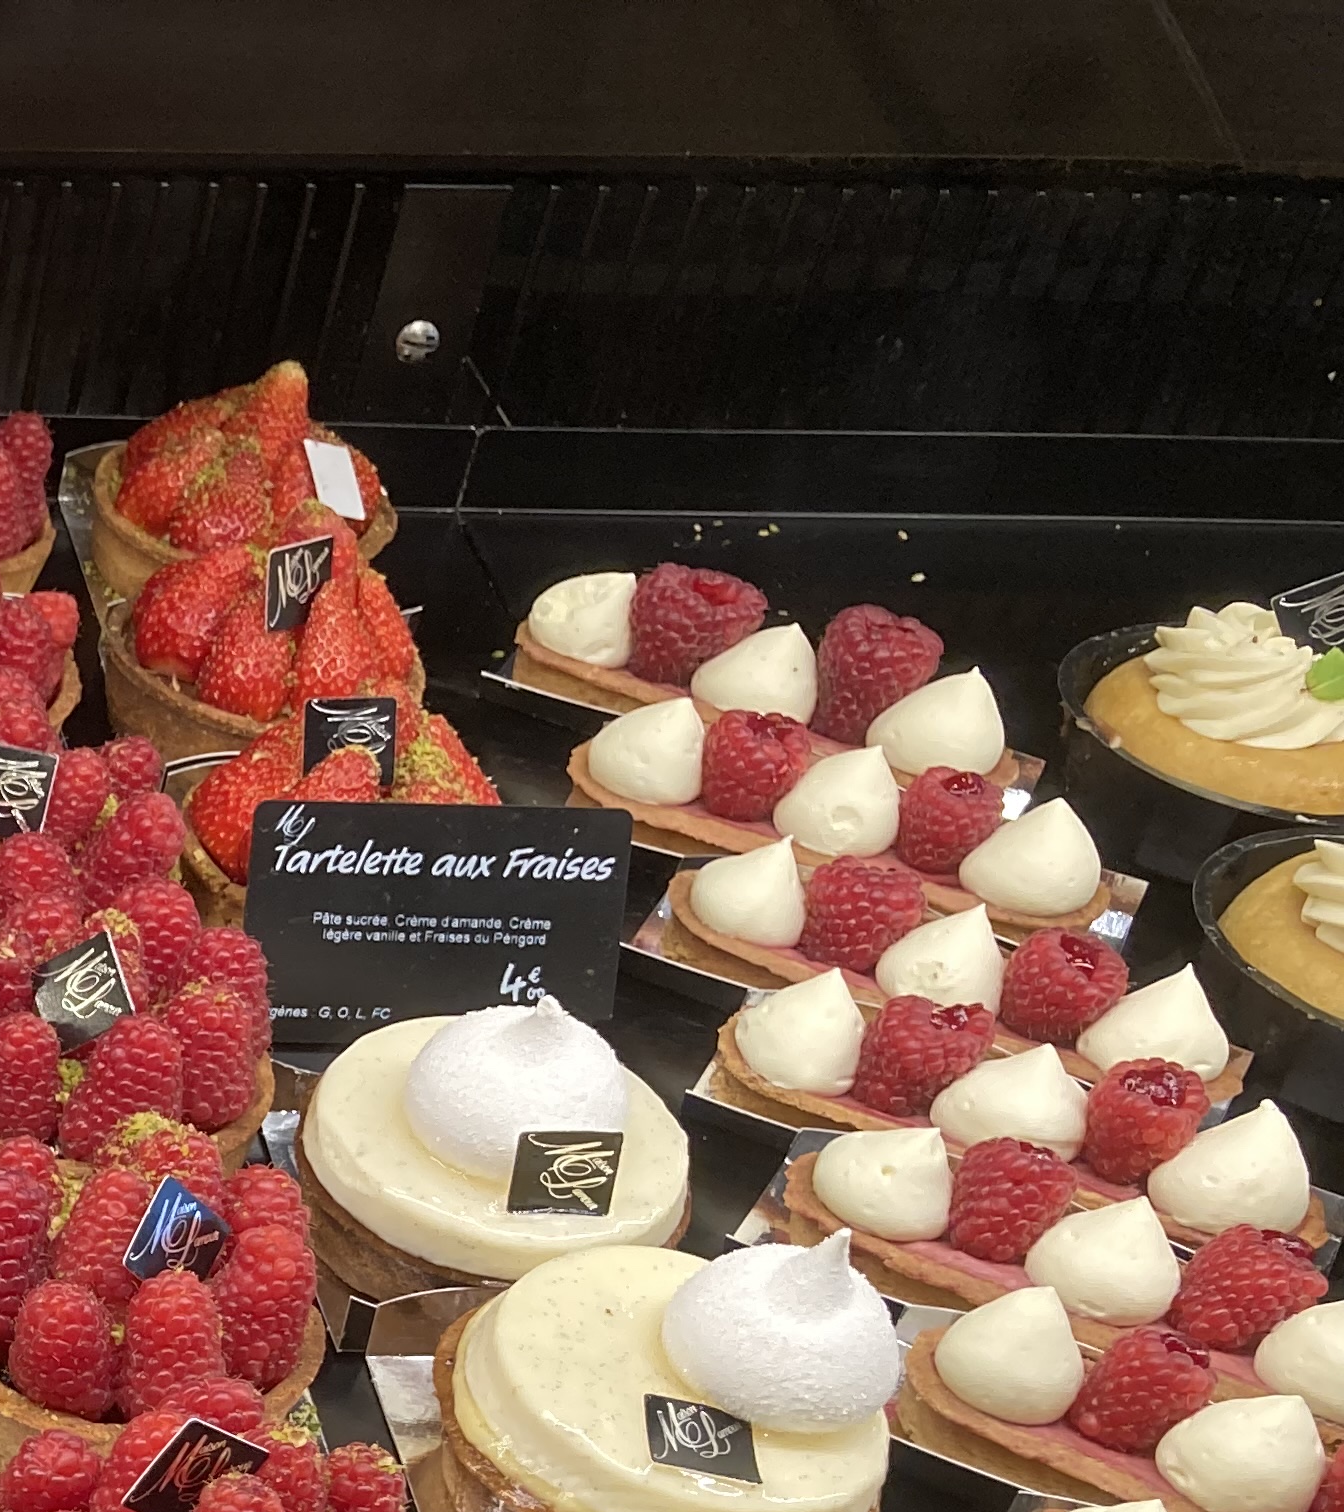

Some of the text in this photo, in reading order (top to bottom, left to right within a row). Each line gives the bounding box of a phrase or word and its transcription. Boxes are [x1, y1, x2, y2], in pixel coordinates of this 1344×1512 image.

[274, 840, 617, 883] Tartelette aux Fraises
[312, 911, 342, 926] Pâte
[394, 914, 438, 928] Crème
[508, 916, 552, 931] Crème
[321, 927, 363, 944] légère
[365, 929, 406, 942] vanille
[408, 930, 421, 943] et
[424, 930, 471, 944] Fraises
[473, 931, 490, 944] du
[371, 1007, 392, 1020] FC
